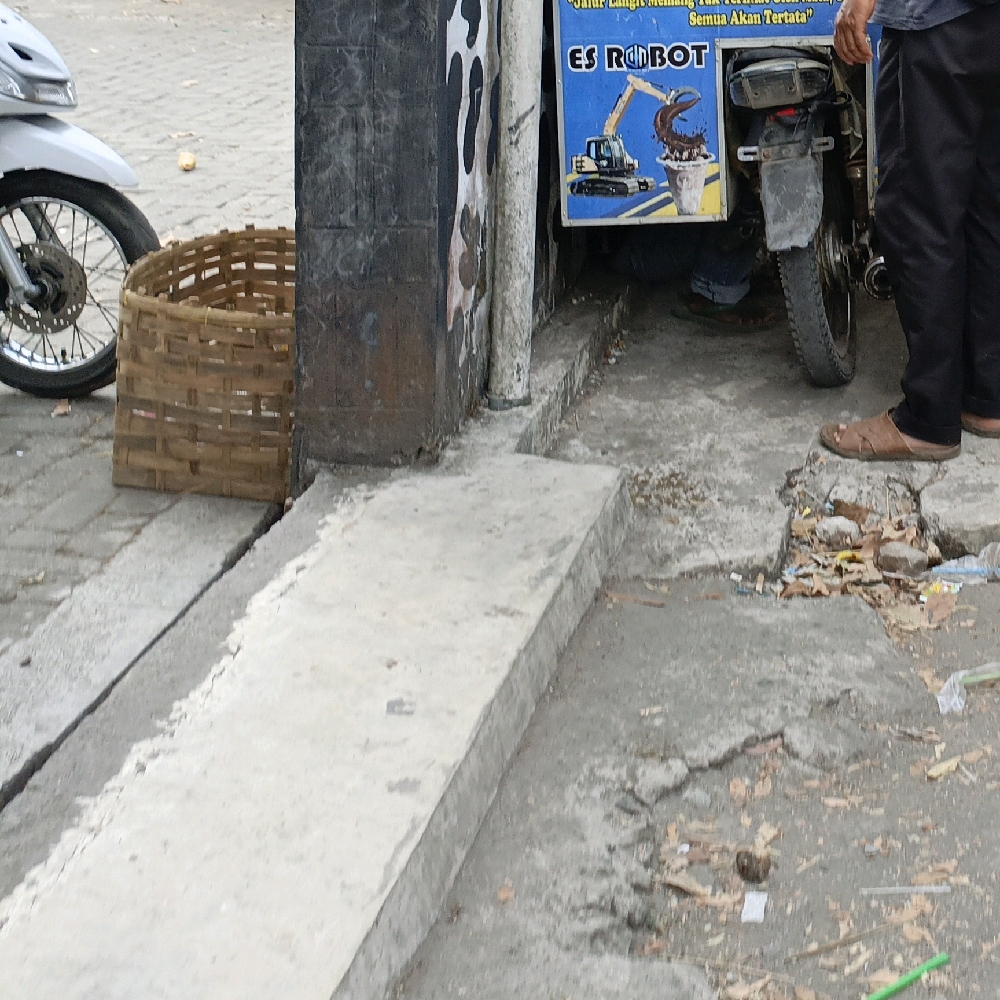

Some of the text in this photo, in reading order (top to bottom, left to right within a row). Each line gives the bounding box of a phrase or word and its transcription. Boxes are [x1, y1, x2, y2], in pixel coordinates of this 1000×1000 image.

[689, 11, 728, 27] Semua
[730, 10, 762, 26] Akan
[569, 43, 709, 71] ES ROBOT
